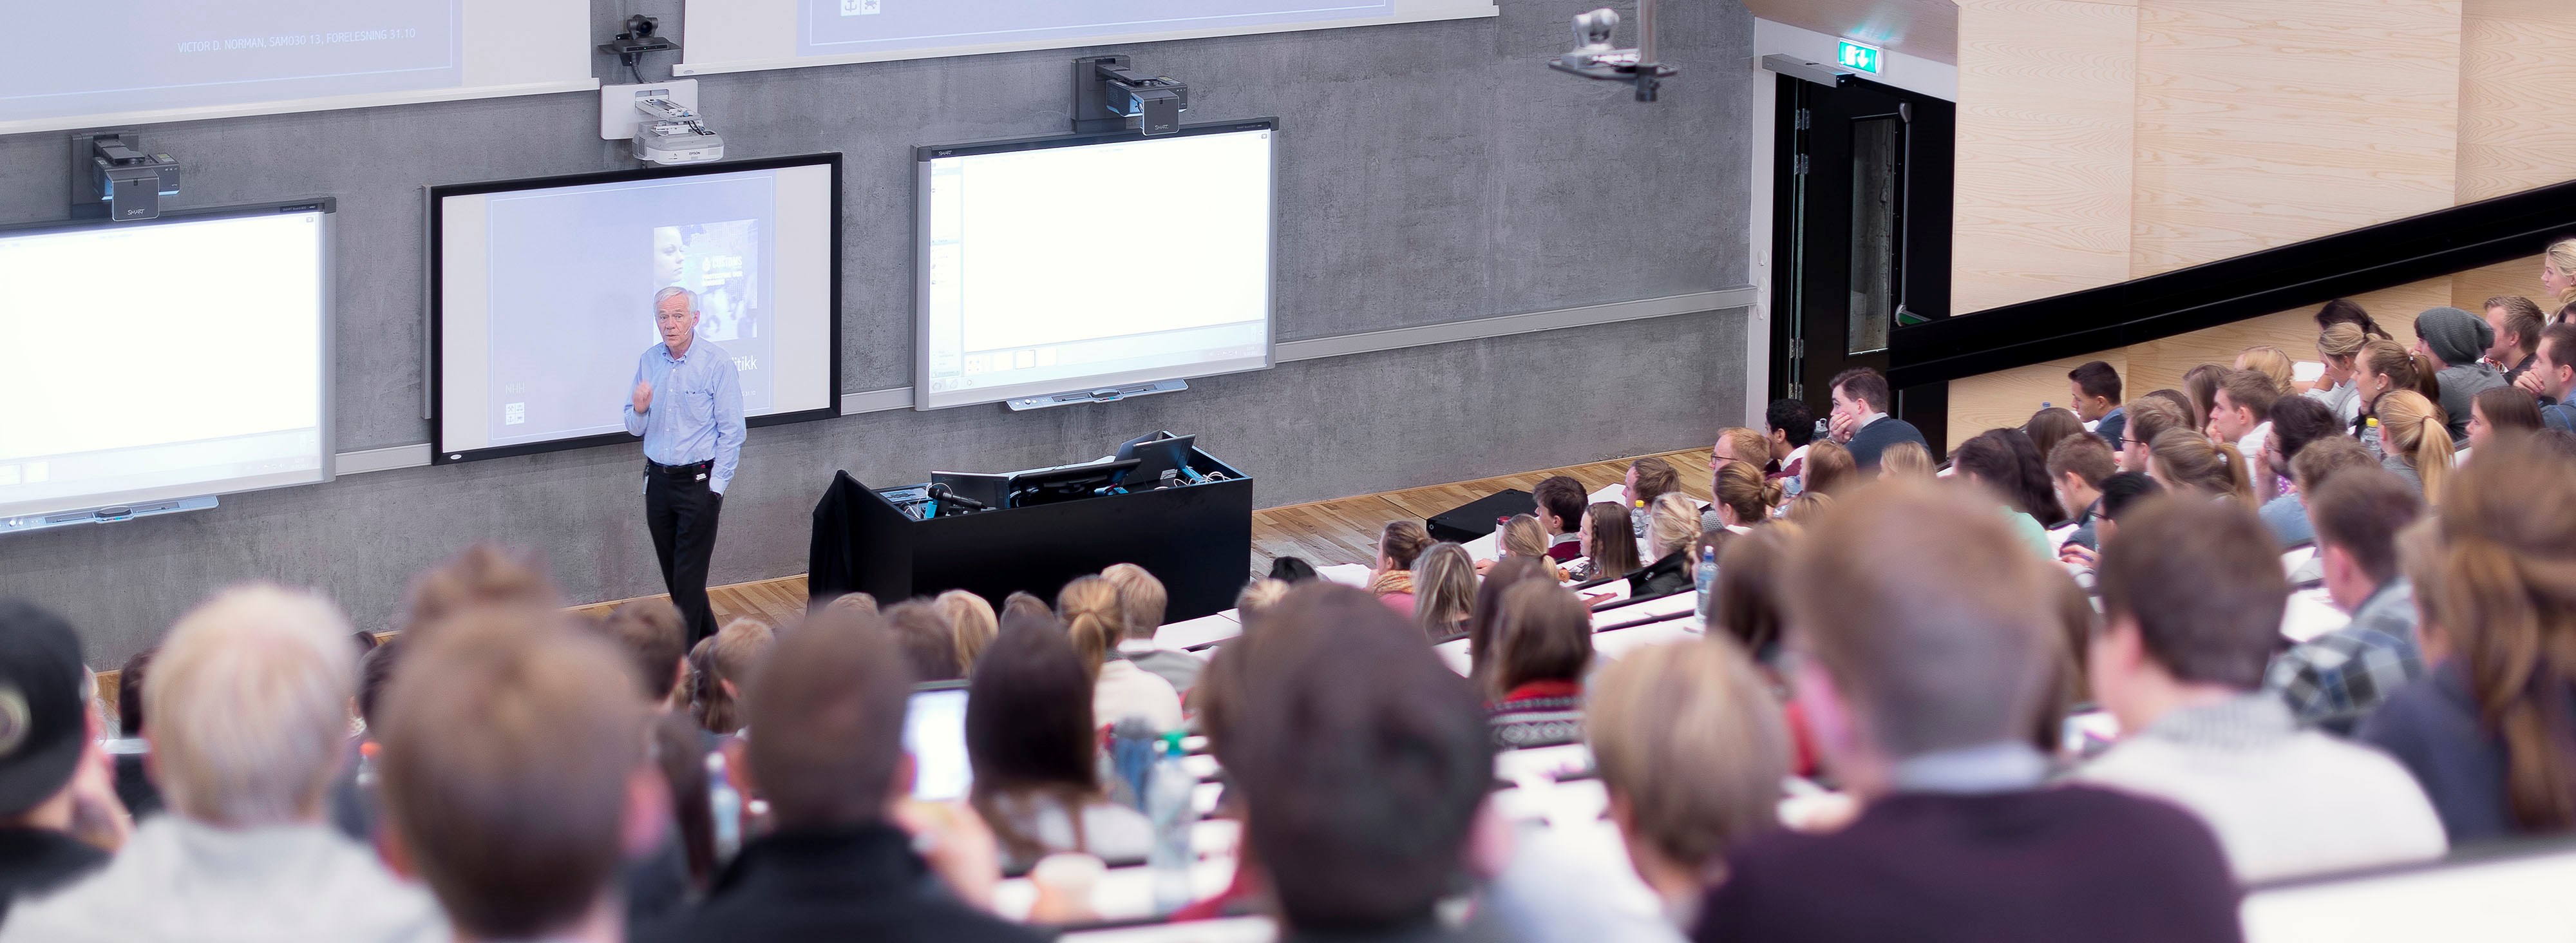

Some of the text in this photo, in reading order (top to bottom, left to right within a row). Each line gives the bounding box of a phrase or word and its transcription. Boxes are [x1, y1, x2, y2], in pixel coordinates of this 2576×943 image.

[178, 41, 211, 53] VICTOR
[213, 41, 222, 51] D.
[225, 37, 267, 50] NORMAN,
[310, 34, 324, 44] 13,
[327, 30, 387, 43] FORELESNING
[390, 28, 416, 39] 31.10
[712, 255, 743, 269] CUSTOMS
[505, 381, 525, 395] NHH
